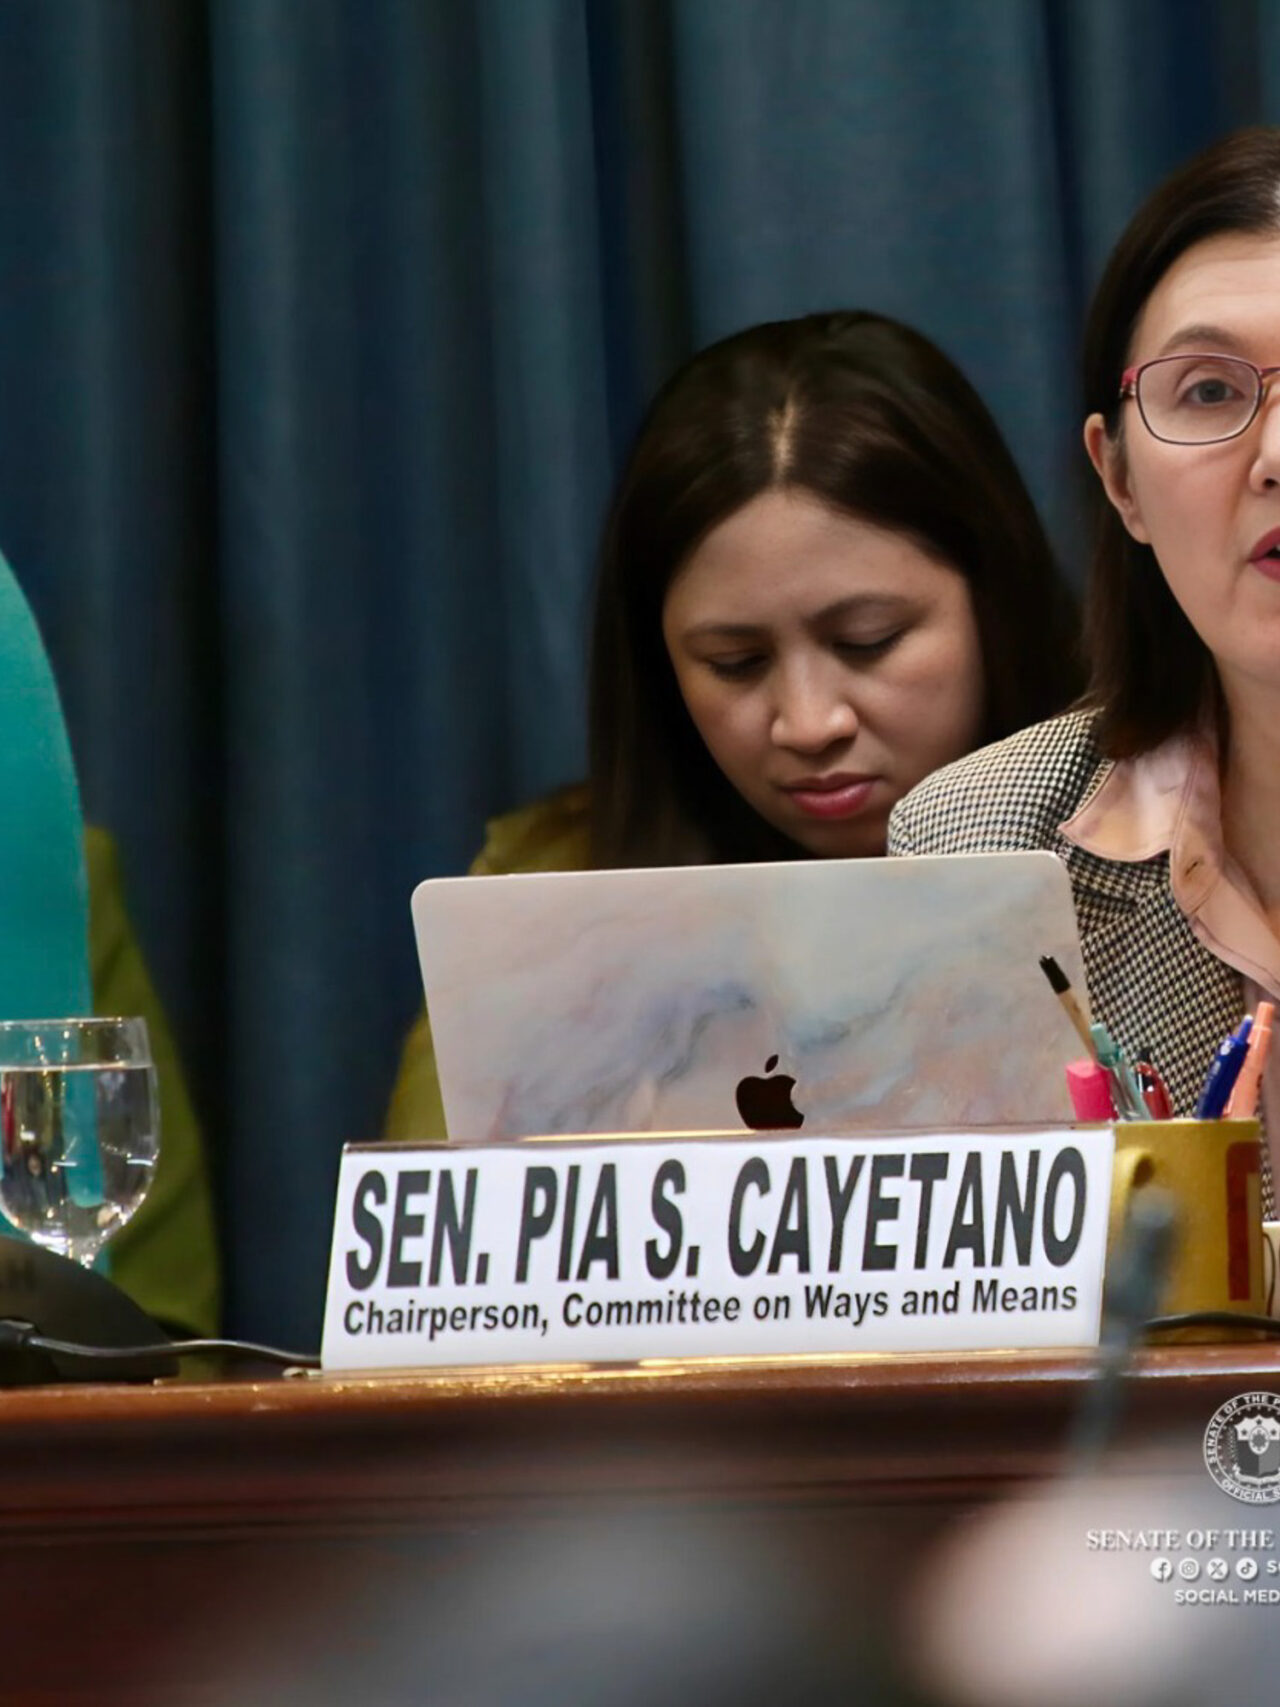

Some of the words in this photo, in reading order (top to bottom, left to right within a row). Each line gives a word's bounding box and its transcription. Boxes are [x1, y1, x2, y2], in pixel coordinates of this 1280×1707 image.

[346, 1169, 489, 1291] SEN.
[515, 1163, 620, 1284] PIA
[645, 1159, 701, 1280] S.
[728, 1146, 1087, 1277] CAYETANO
[344, 1300, 548, 1341] Chairperson,
[563, 1290, 740, 1327] Committee
[753, 1293, 790, 1319] on
[804, 1283, 888, 1326] Ways
[901, 1280, 960, 1315] and
[972, 1278, 1077, 1313] Means
